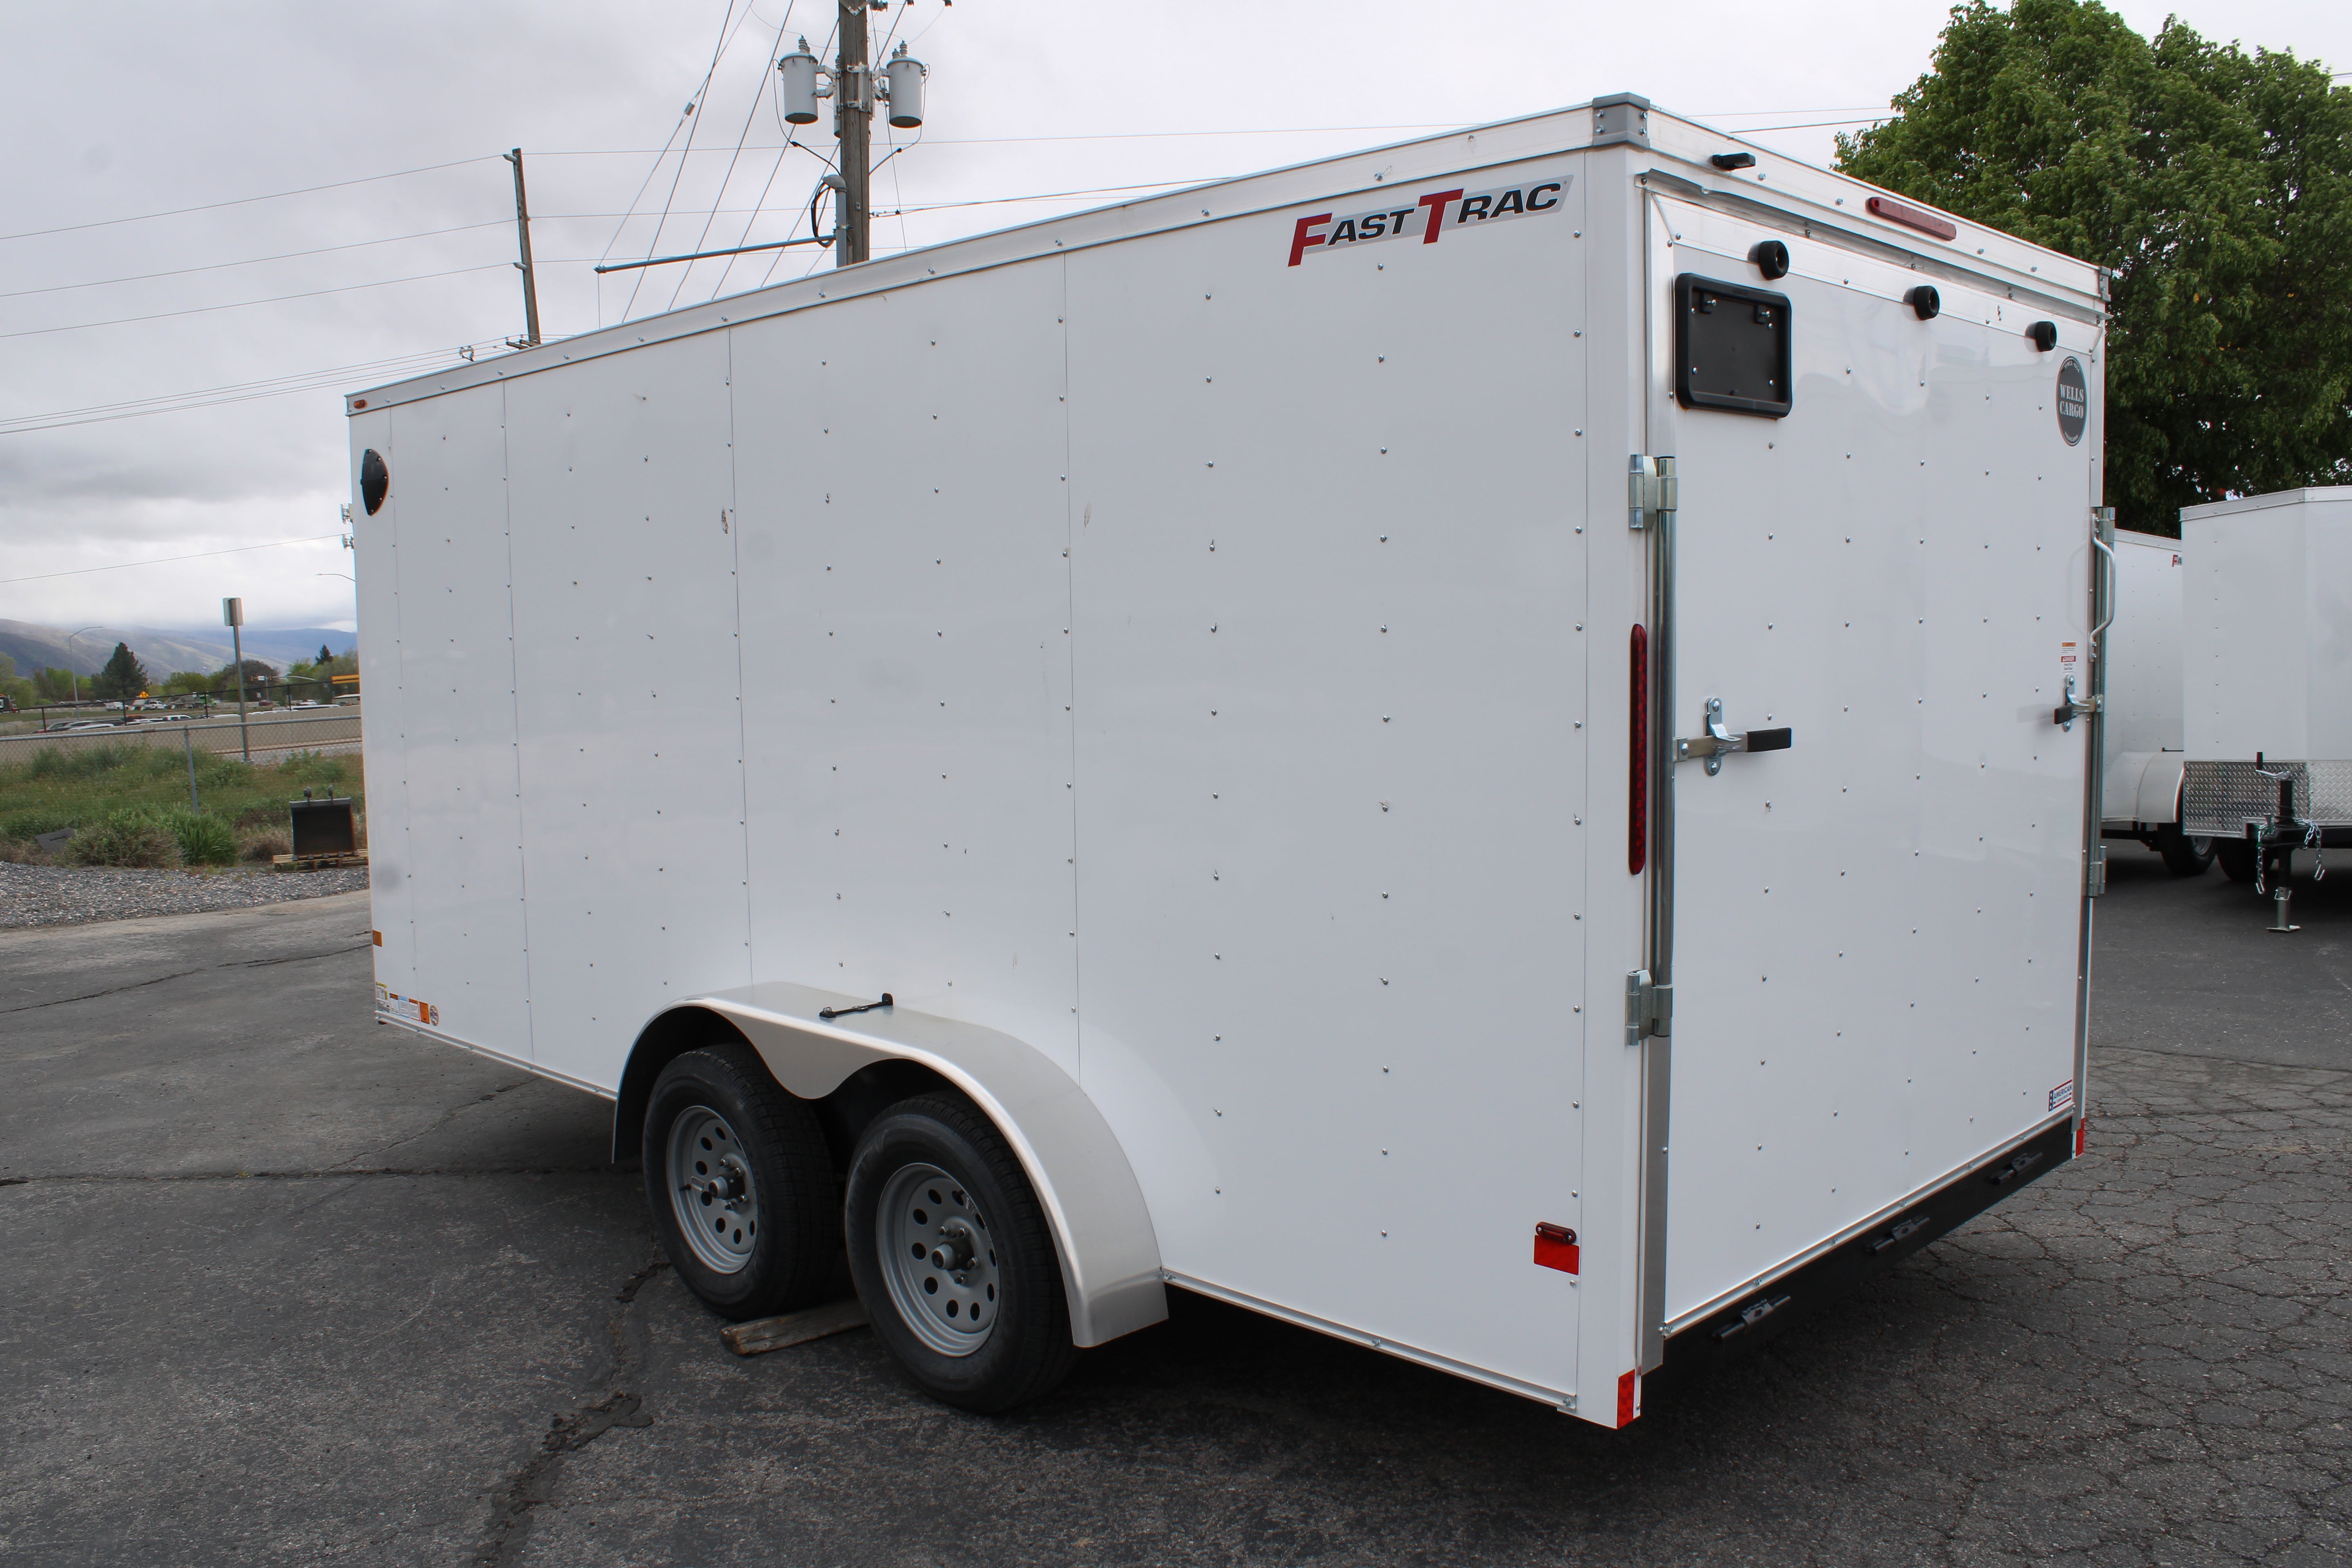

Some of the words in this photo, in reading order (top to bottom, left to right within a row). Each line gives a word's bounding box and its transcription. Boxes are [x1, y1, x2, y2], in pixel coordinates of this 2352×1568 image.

[1288, 208, 1415, 267] FAST
[1418, 183, 1561, 245] TRAC
[2059, 384, 2084, 403] WELLS
[2059, 401, 2083, 419] CARGO
